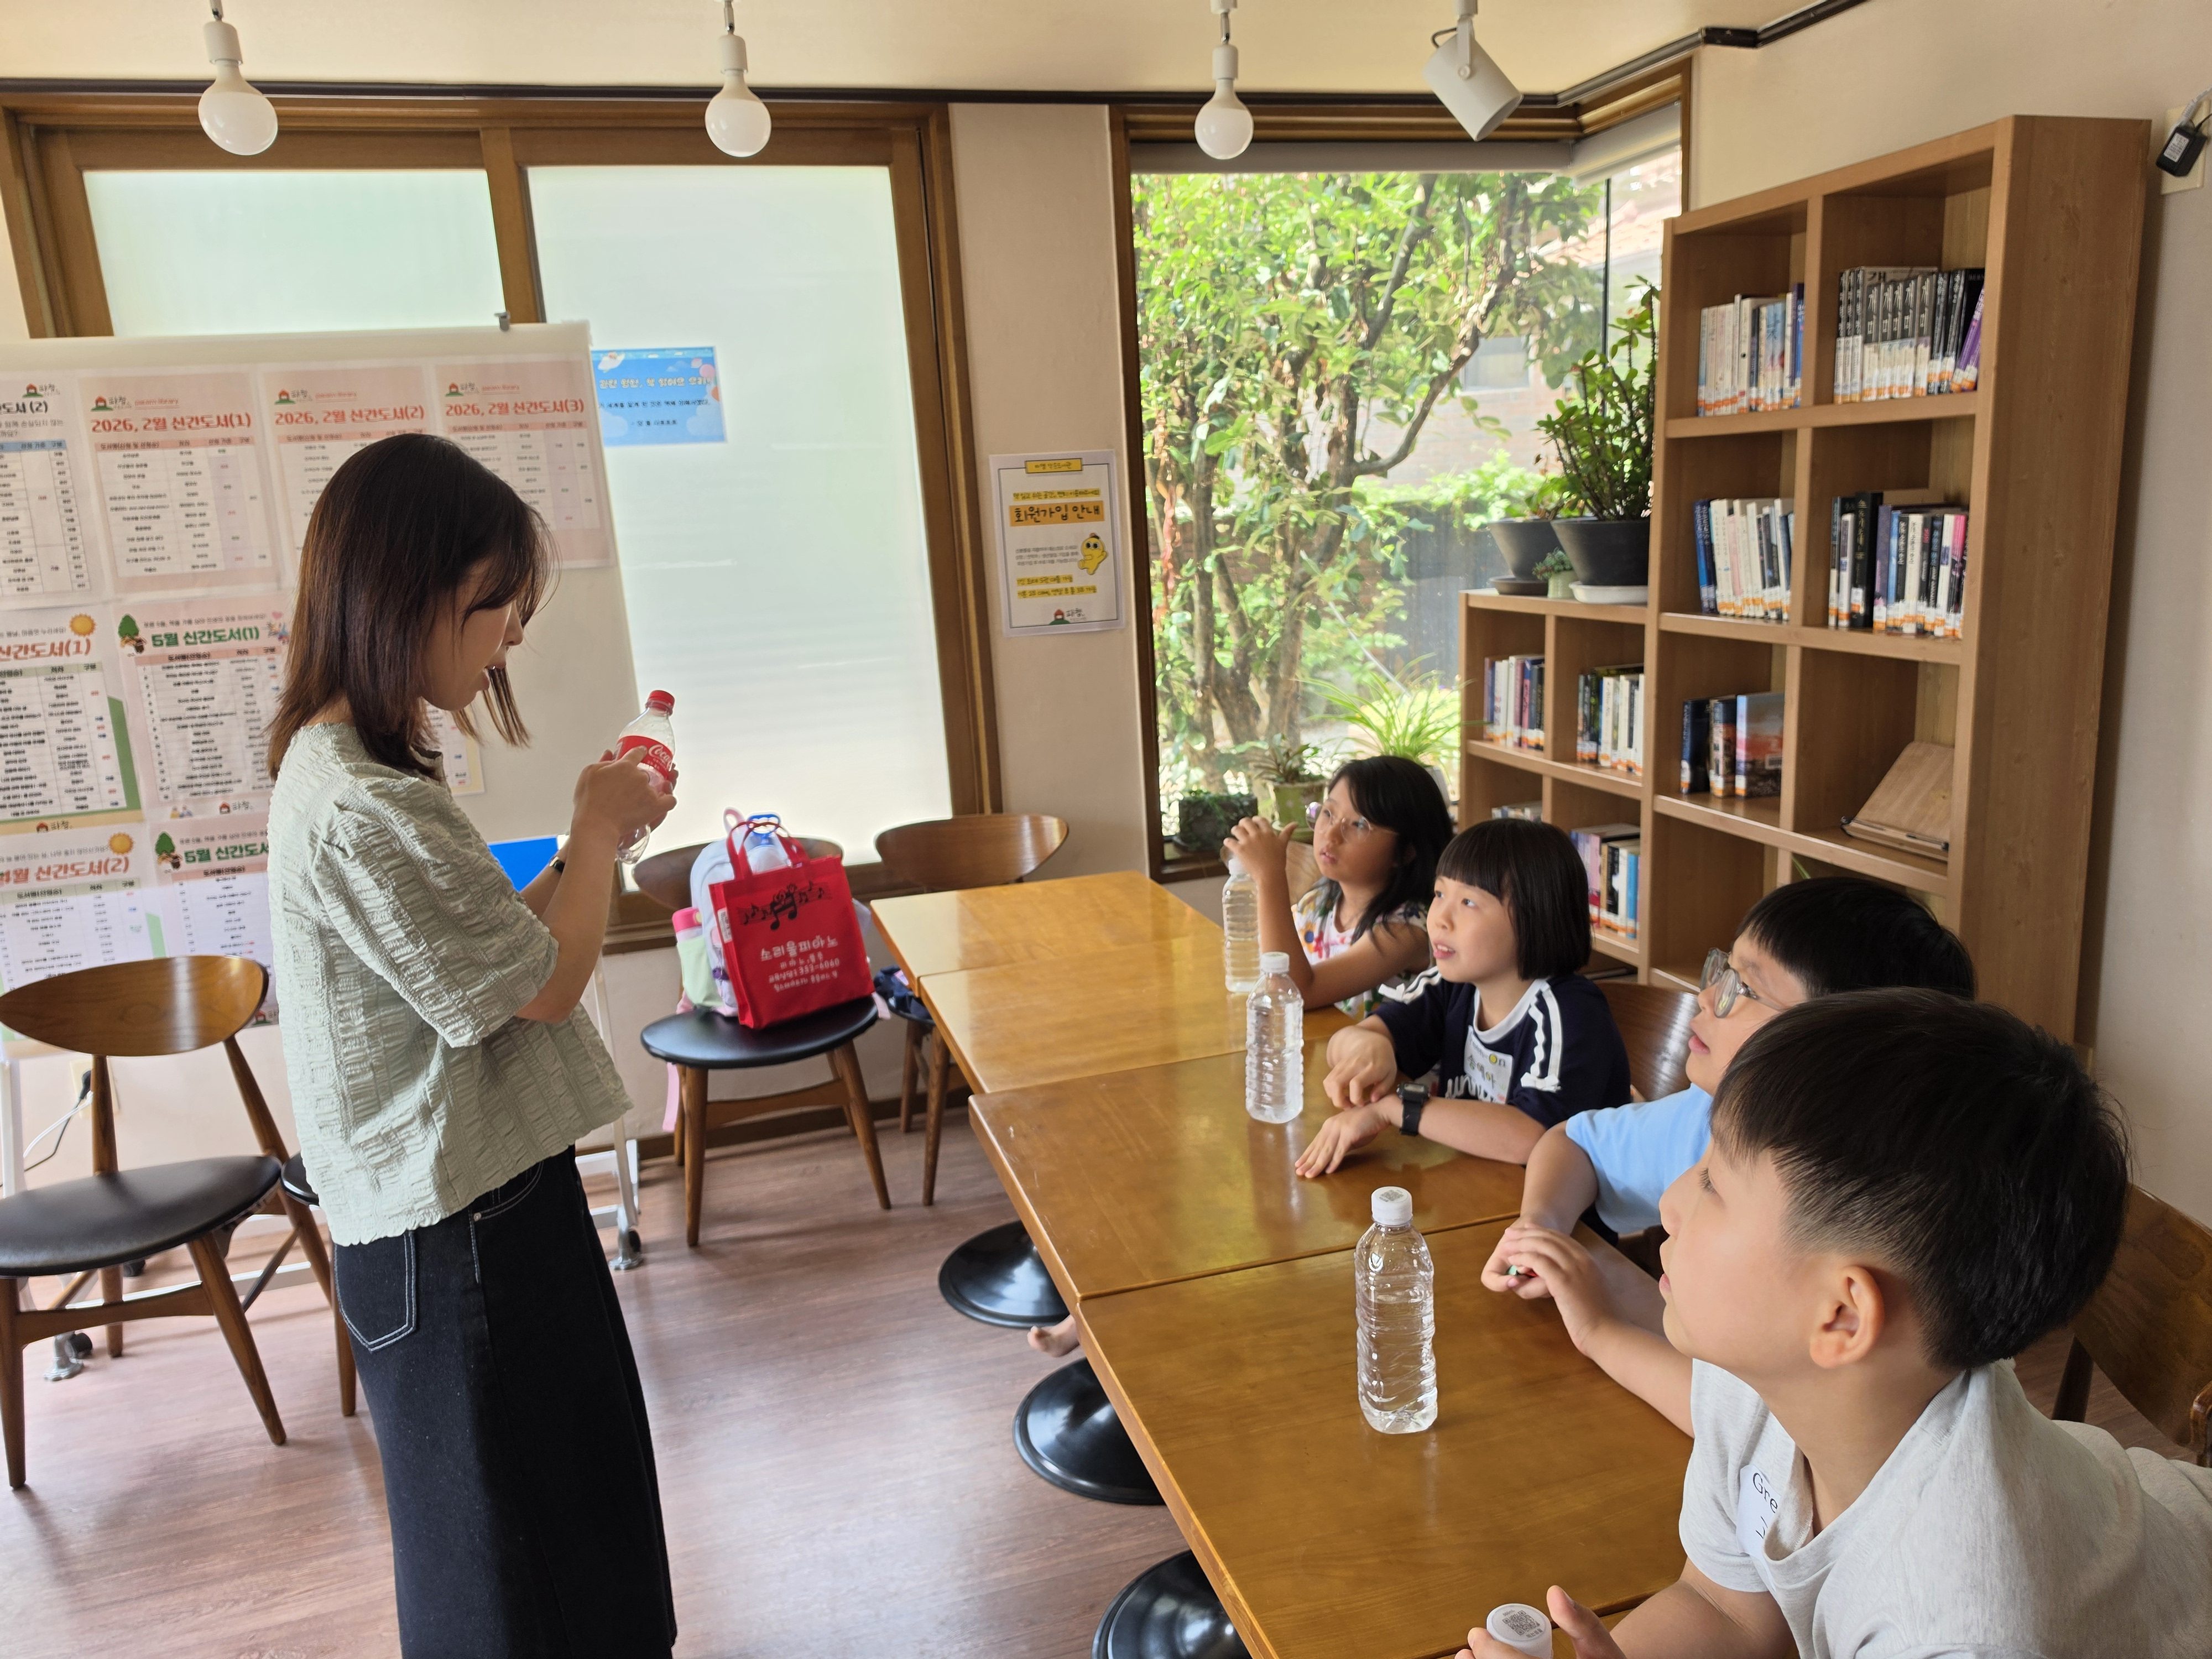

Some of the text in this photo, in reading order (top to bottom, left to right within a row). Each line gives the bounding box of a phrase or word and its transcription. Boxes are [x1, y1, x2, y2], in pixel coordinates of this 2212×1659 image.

[275, 405, 425, 425] 2026, 2월 신간도서(2)
[446, 398, 584, 416] 2026, 2월 신간도서(3)
[91, 412, 252, 433] 2026, 2월 신간도서(1)
[1014, 505, 1100, 523] 회원가입 안내
[151, 626, 260, 648] 5월 신간도서(1)
[184, 847, 211, 864] 5월
[35, 857, 129, 882] 신간도서(2)
